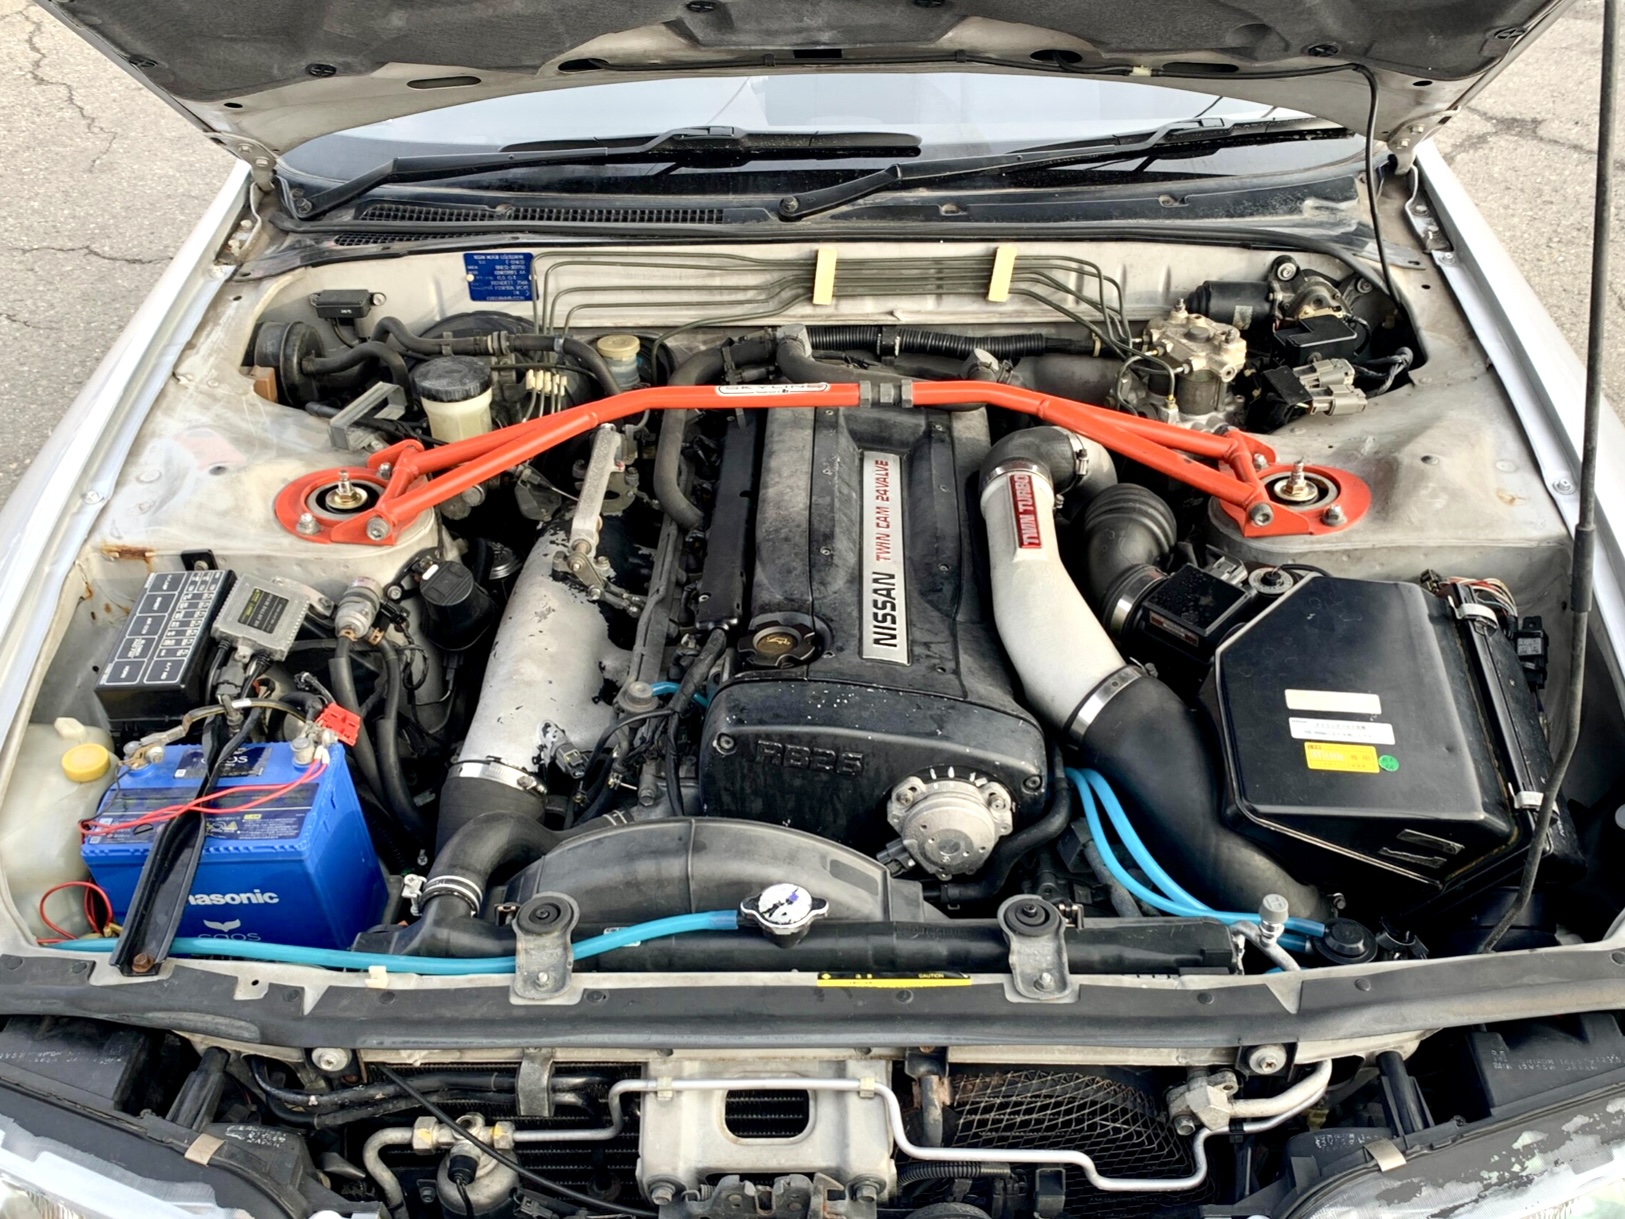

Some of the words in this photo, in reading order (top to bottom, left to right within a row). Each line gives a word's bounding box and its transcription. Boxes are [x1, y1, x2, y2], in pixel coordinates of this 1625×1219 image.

[874, 459, 891, 502] 24VALVE
[1013, 475, 1034, 513] TURBO
[875, 506, 891, 530] CAM
[1019, 514, 1039, 545] TWIN
[875, 532, 891, 562] TWIN
[872, 571, 898, 648] NISSAN
